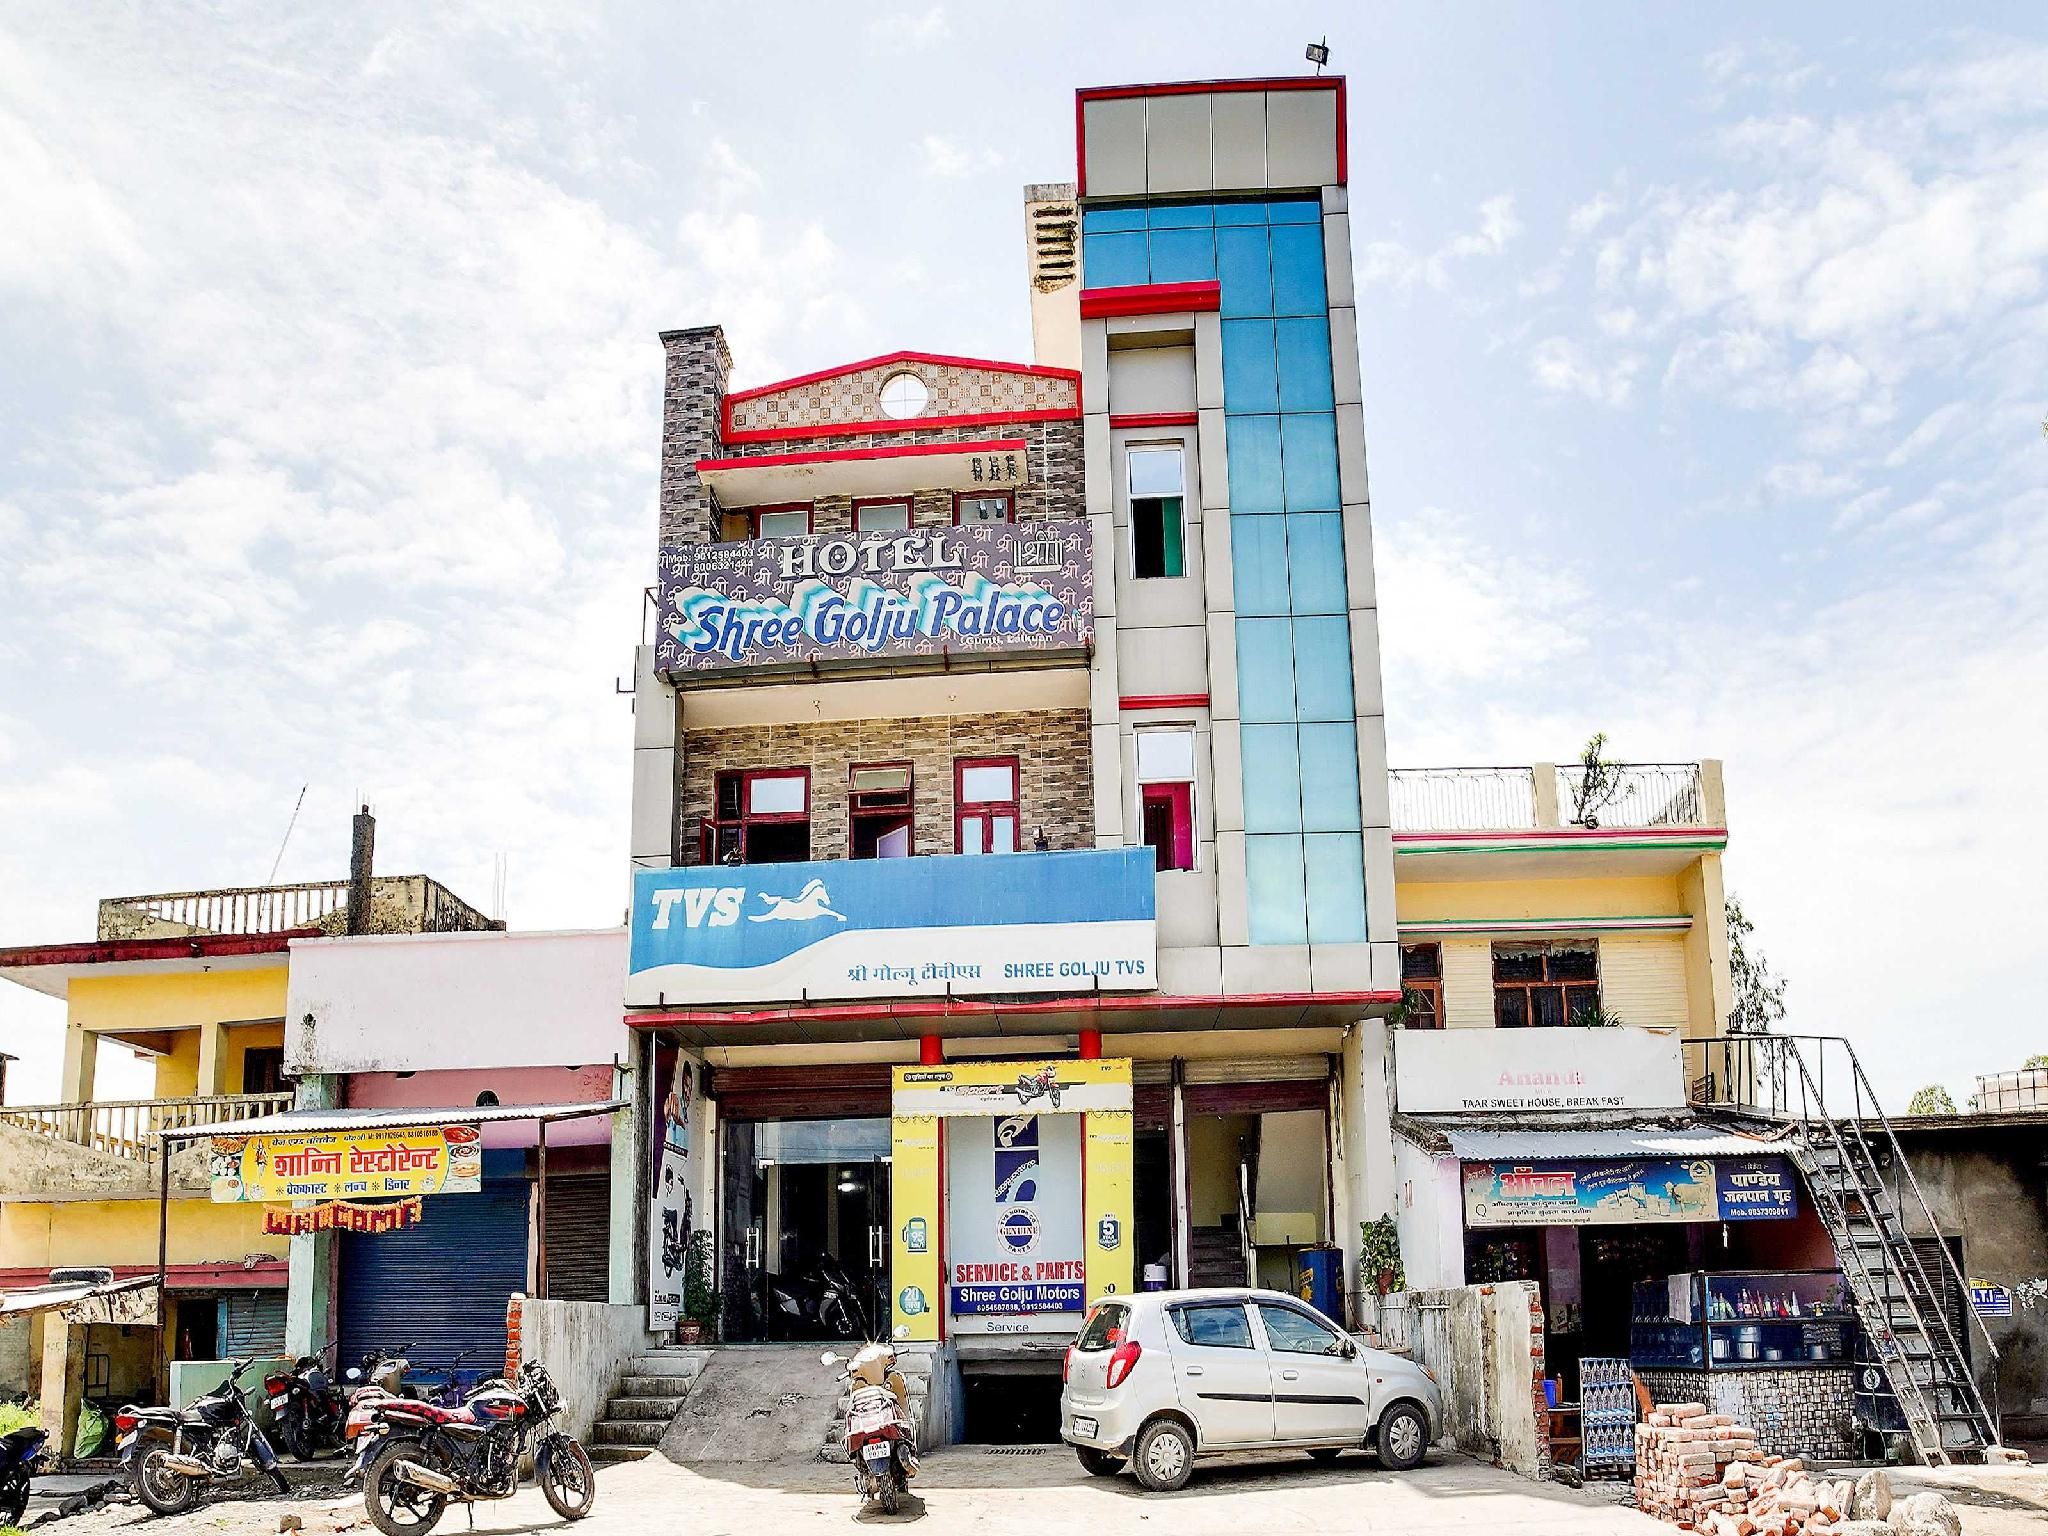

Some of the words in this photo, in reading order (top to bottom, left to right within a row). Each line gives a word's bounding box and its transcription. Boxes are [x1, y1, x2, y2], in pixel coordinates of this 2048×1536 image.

[668, 552, 692, 564] Mob:
[693, 548, 754, 562] 9012584403
[780, 534, 963, 579] HOTEL
[693, 604, 804, 661] Shree
[814, 596, 919, 652] Golju
[930, 590, 1065, 635] Palace
[652, 887, 746, 930] TVS
[848, 964, 868, 981] श्री
[921, 962, 982, 980] टीवीएस
[1004, 962, 1054, 978] SHREE
[1059, 961, 1110, 976] GOLJU
[1115, 960, 1145, 976] TVS
[1462, 1099, 1488, 1108] TAAR
[1491, 1098, 1524, 1108] SWEET
[1527, 1097, 1565, 1108] HOUSE,
[1567, 1096, 1599, 1106] BREAK
[1601, 1096, 1625, 1106] FAST
[274, 1147, 342, 1177] शान्ति
[350, 1143, 440, 1173] रेस्टोरेन्ट
[344, 1181, 368, 1193] लन्च
[384, 1178, 411, 1191] डिनर
[1730, 1171, 1781, 1187] पाण्डेय
[1722, 1190, 1769, 1203] जलपान
[1772, 1190, 1792, 1205] गृह
[1730, 1208, 1747, 1216] Mob.
[956, 1263, 1019, 1283] SERVICE
[1021, 1266, 1033, 1281] &
[1036, 1260, 1084, 1281] PARTS
[904, 1287, 920, 1301] 20
[960, 1288, 997, 1302] Shree
[1000, 1287, 1033, 1303] Golju
[1036, 1286, 1080, 1300] Motors
[986, 1322, 1029, 1332] Service
